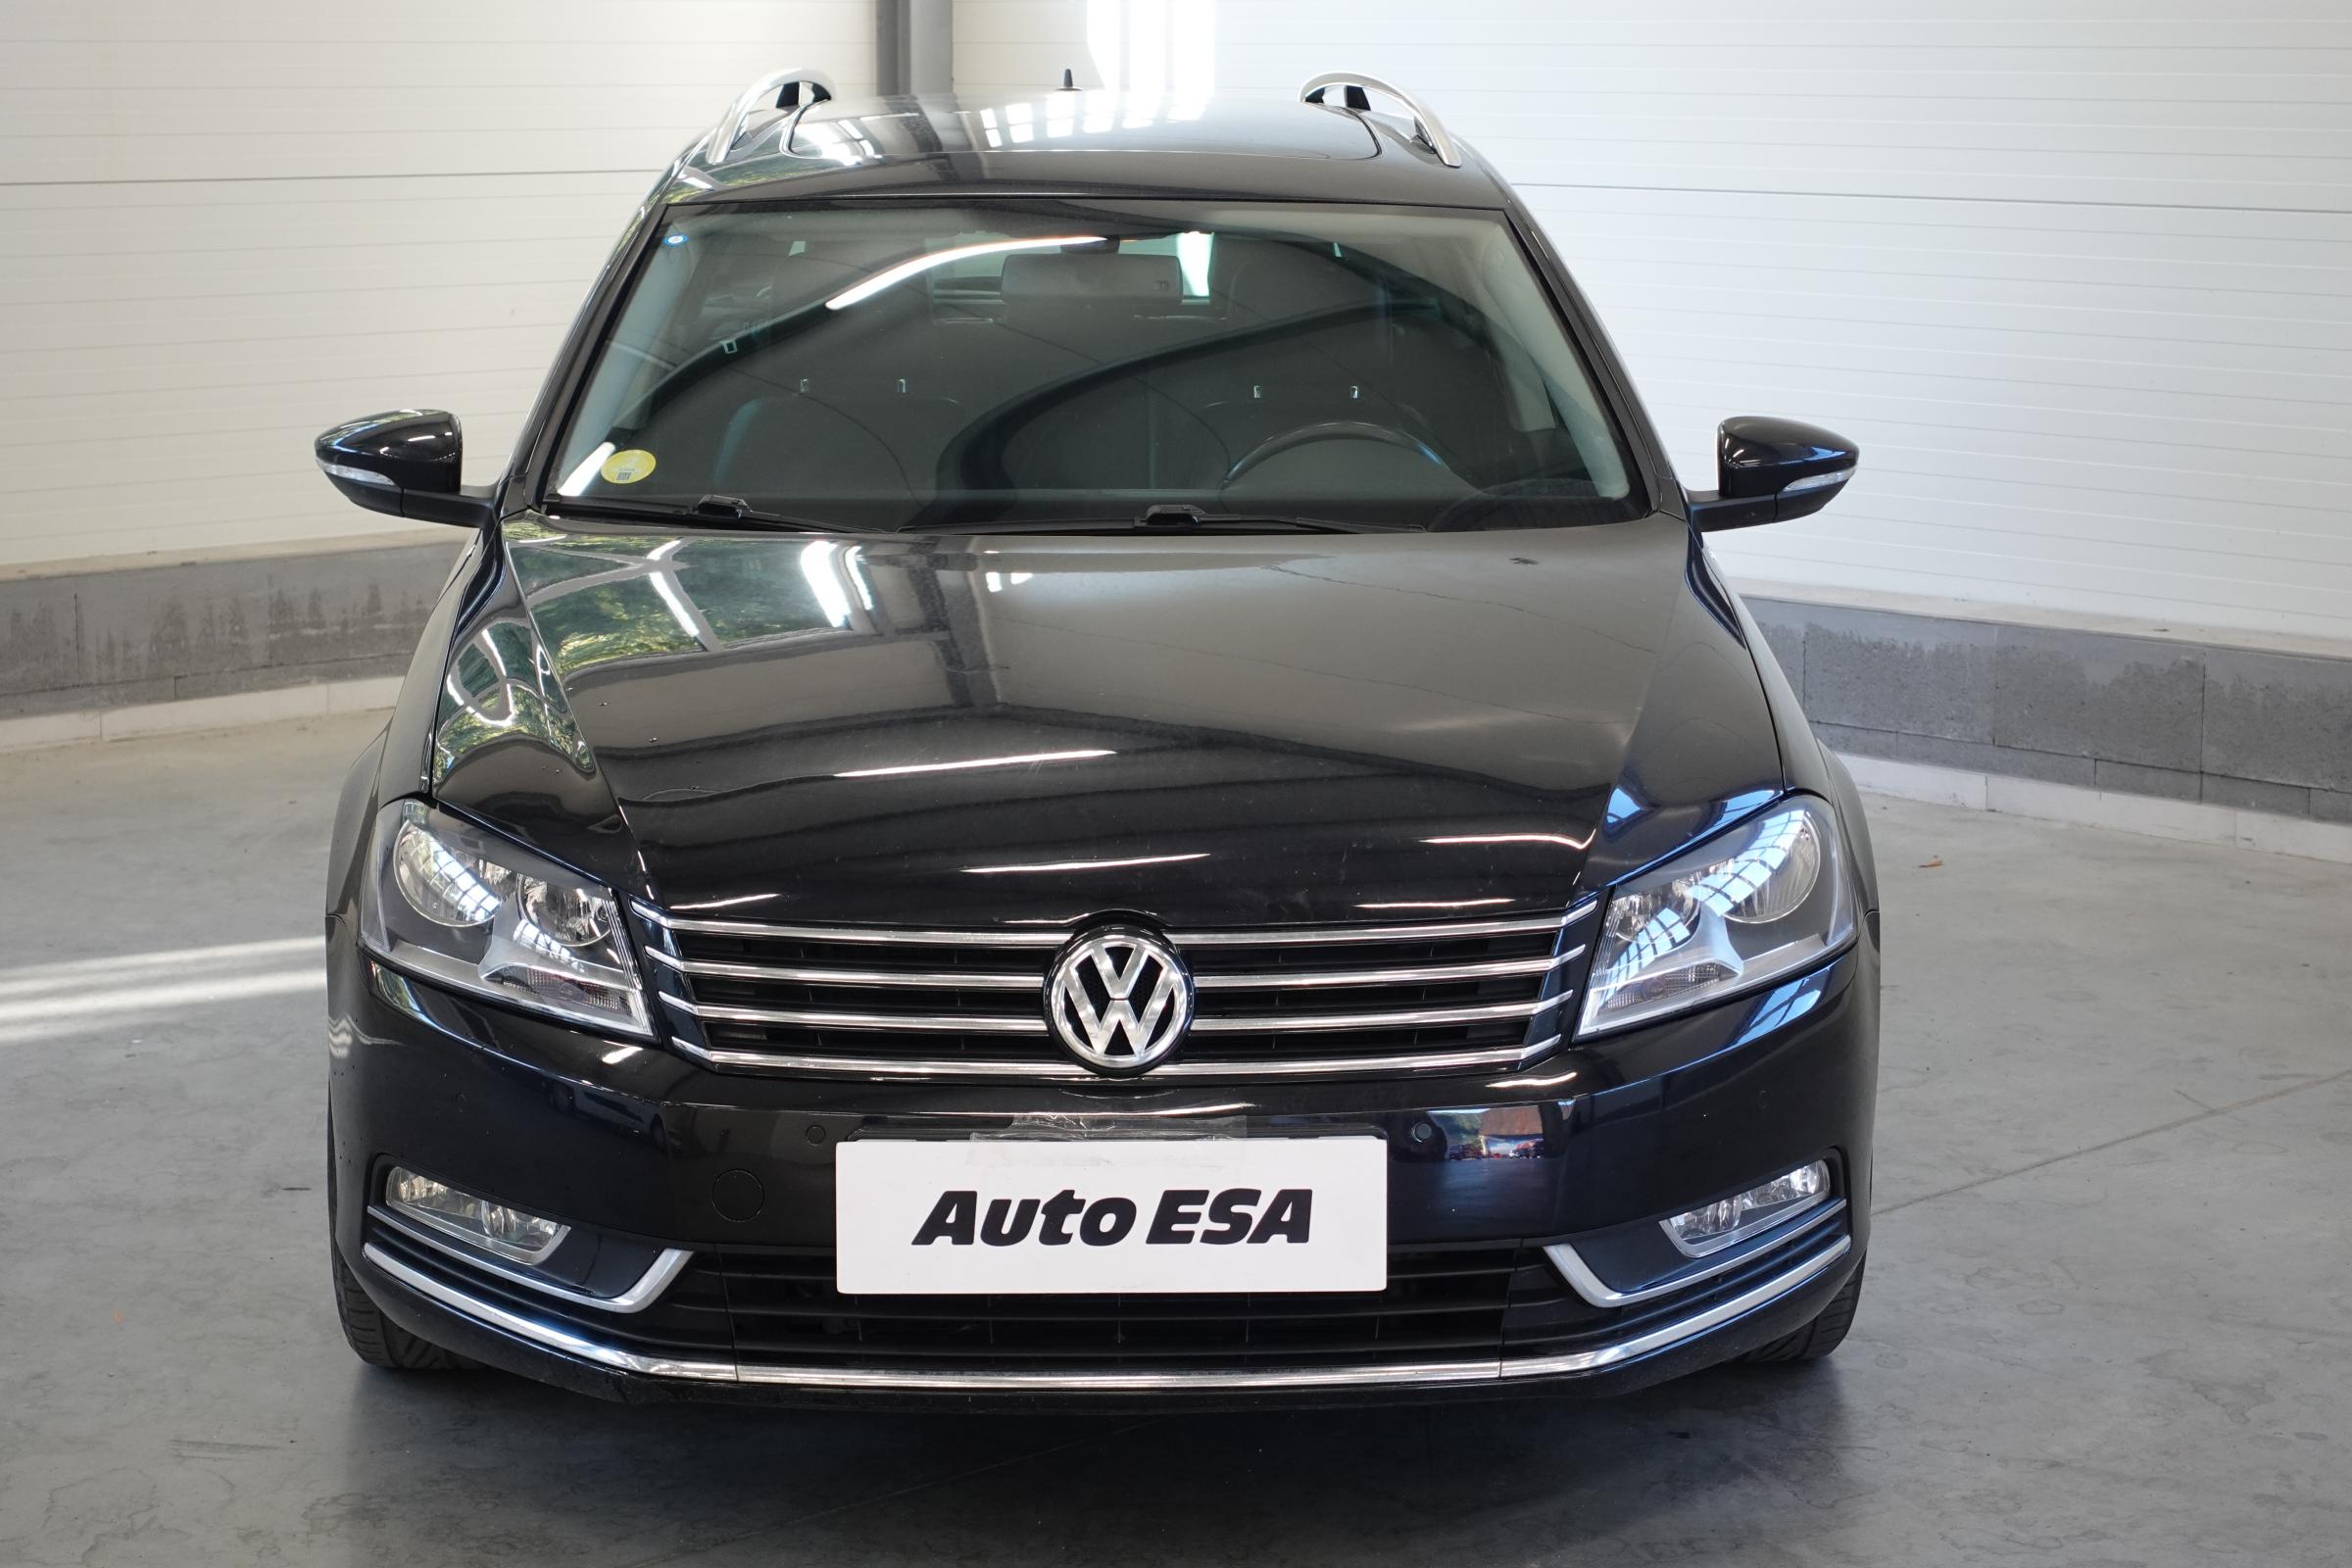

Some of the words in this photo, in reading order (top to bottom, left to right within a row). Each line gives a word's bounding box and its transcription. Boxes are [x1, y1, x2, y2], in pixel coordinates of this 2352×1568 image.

[1054, 938, 1184, 1064] VW
[910, 1189, 1137, 1247] Auto
[1146, 1188, 1313, 1246] ESA
